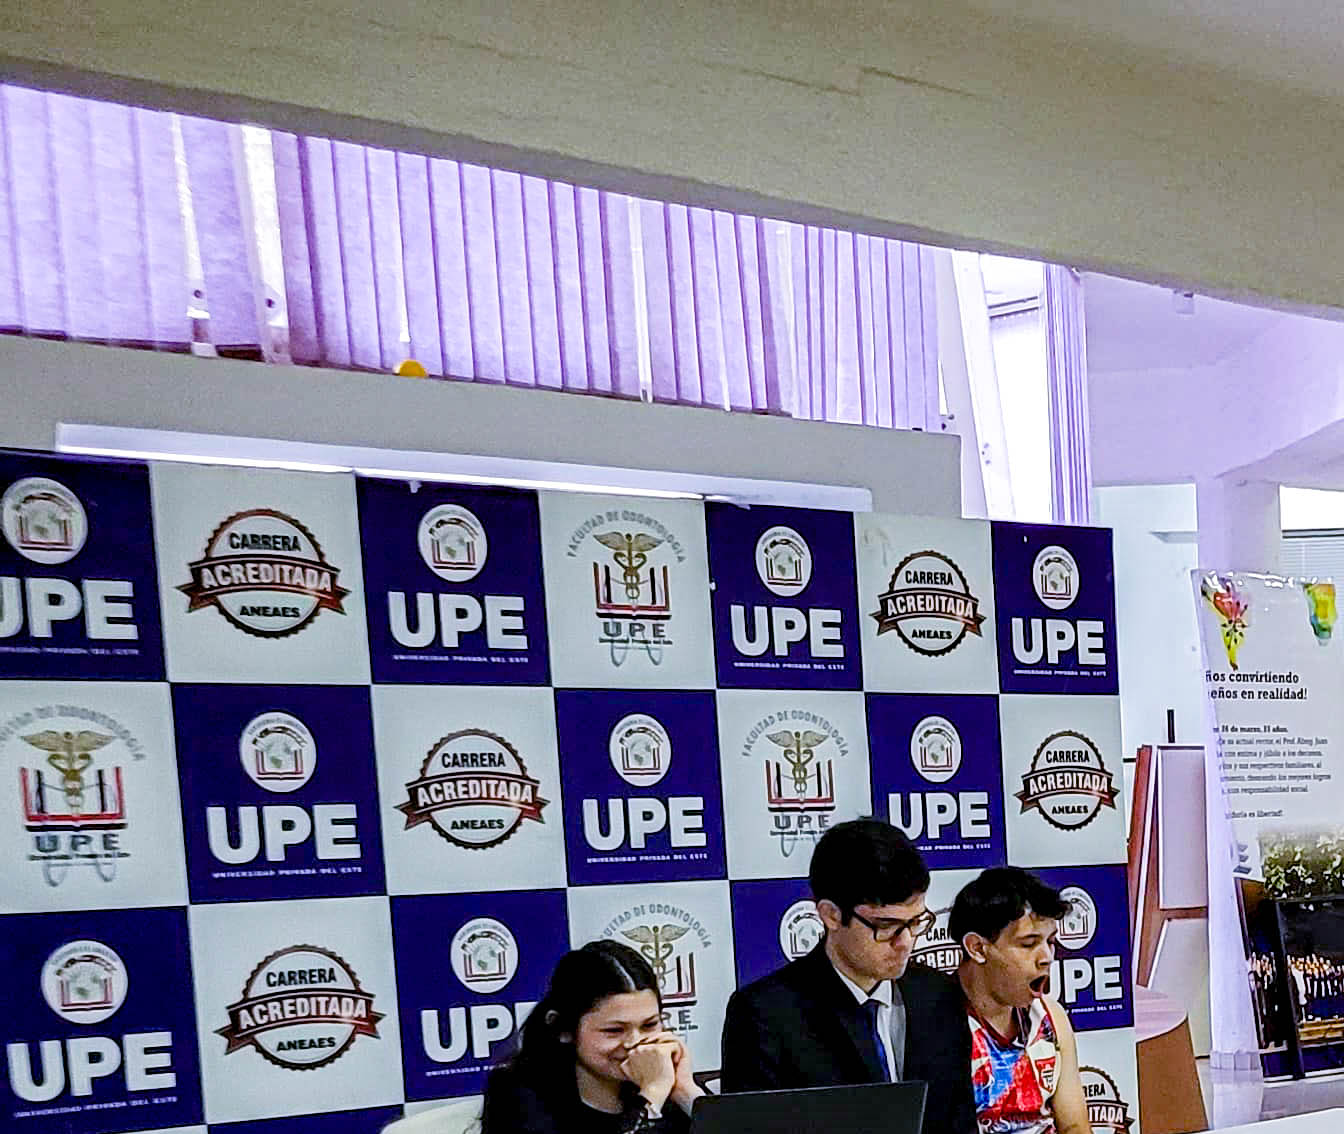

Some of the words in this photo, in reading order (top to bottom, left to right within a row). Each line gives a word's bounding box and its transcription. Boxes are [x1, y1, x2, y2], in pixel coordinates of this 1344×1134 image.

[229, 532, 301, 551] CARRERA
[567, 515, 604, 557] FACULTAD
[200, 563, 332, 592] ACREDITADA
[905, 570, 953, 585] CARRERA
[239, 606, 300, 618] ANEAES
[887, 594, 974, 619] ACREDITADA
[387, 591, 529, 649] UPE
[603, 621, 666, 638] UPE
[730, 604, 845, 658] UPE
[911, 630, 952, 640] ANEAES
[1011, 617, 1107, 665] UPE
[1205, 670, 1226, 683] ños
[1228, 670, 1300, 684] convirtiendo
[1209, 687, 1238, 700] eños
[1240, 689, 1255, 700] en
[1257, 687, 1308, 700] realidad!
[741, 715, 775, 757] FACULTAD
[777, 710, 788, 721] DE
[441, 752, 506, 768] CARRERA
[1046, 750, 1090, 763] CARRERA
[417, 780, 533, 807] ACREDITADA
[1029, 772, 1108, 796] ACREDITADA
[451, 819, 505, 830] ANEAES
[582, 796, 707, 851] UPE
[774, 815, 830, 830] UPE
[888, 792, 991, 841] UPE
[34, 833, 121, 853] UPE
[206, 804, 362, 864] UPE
[633, 904, 645, 917] DE
[266, 967, 338, 987] CARRERA
[238, 996, 367, 1030] ACREDITADA
[421, 1001, 539, 1063] UP
[276, 1037, 336, 1051] ANEAES
[6, 1031, 177, 1102] UPE
[1088, 1105, 1124, 1124] ITADA
